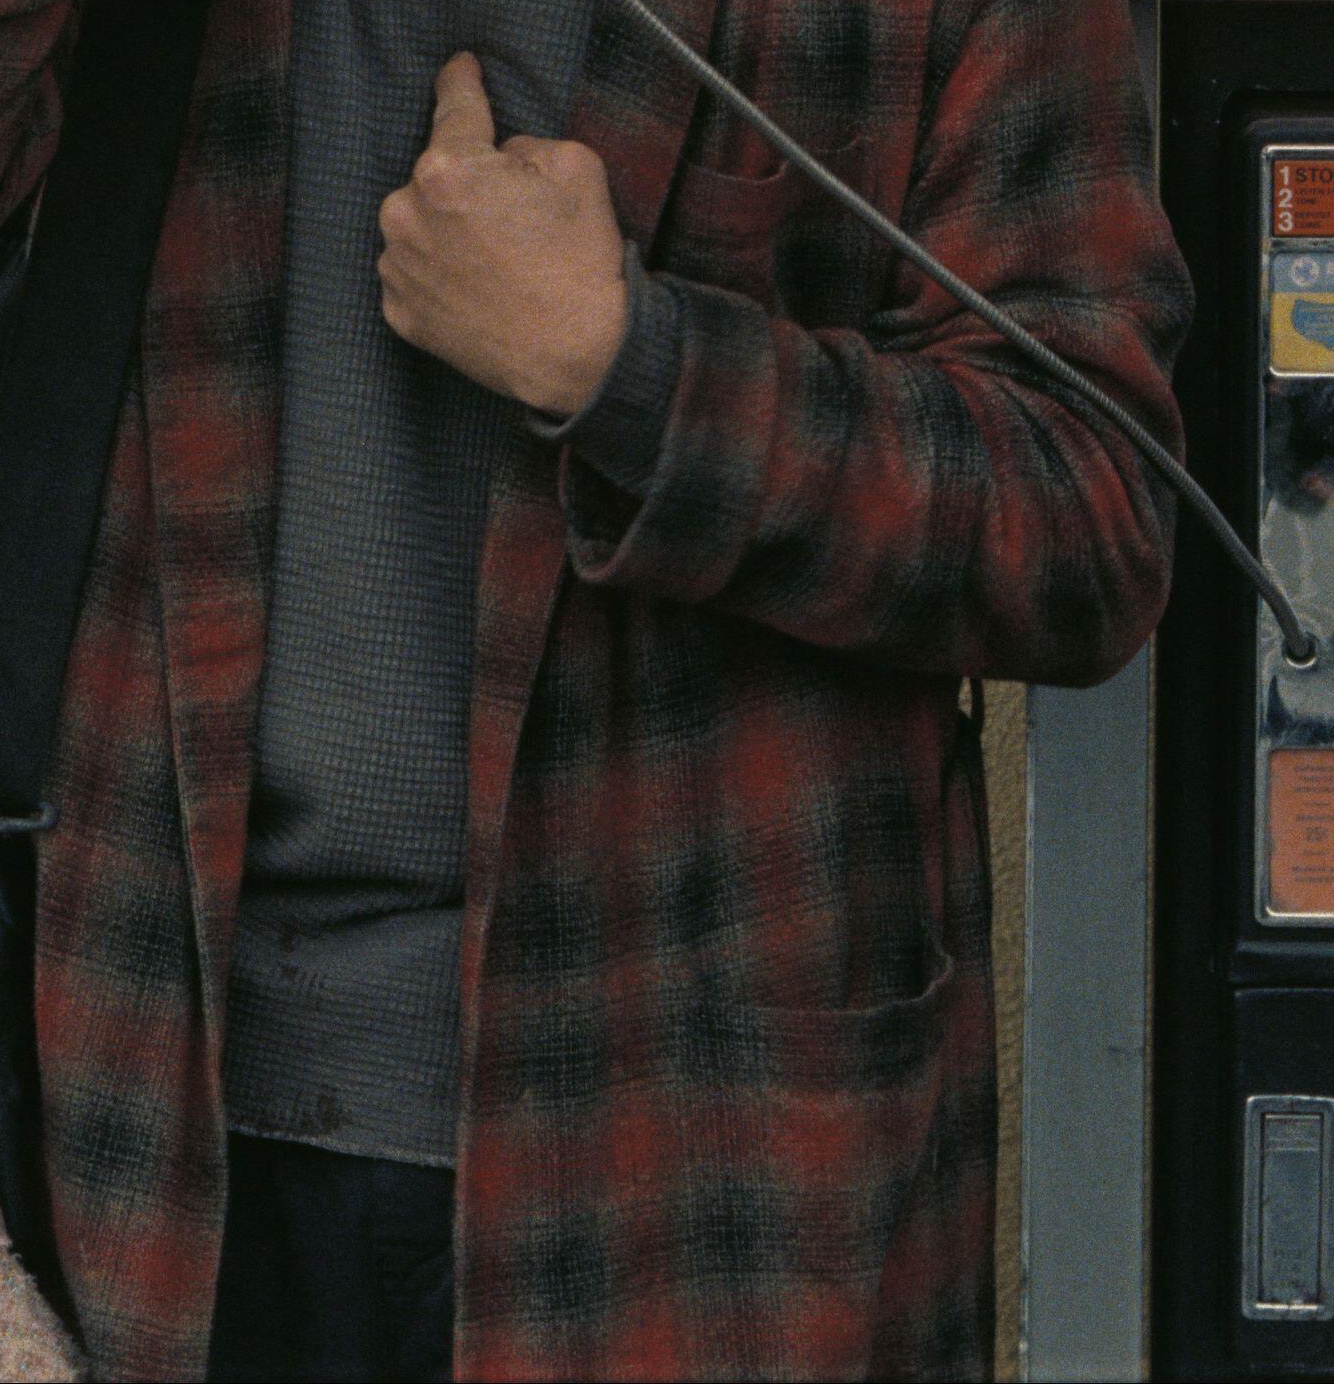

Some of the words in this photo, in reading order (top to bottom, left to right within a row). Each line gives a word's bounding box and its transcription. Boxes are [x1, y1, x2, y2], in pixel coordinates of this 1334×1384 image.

[1279, 166, 1290, 185] 1
[1278, 188, 1294, 208] 2
[1278, 212, 1294, 232] 3
